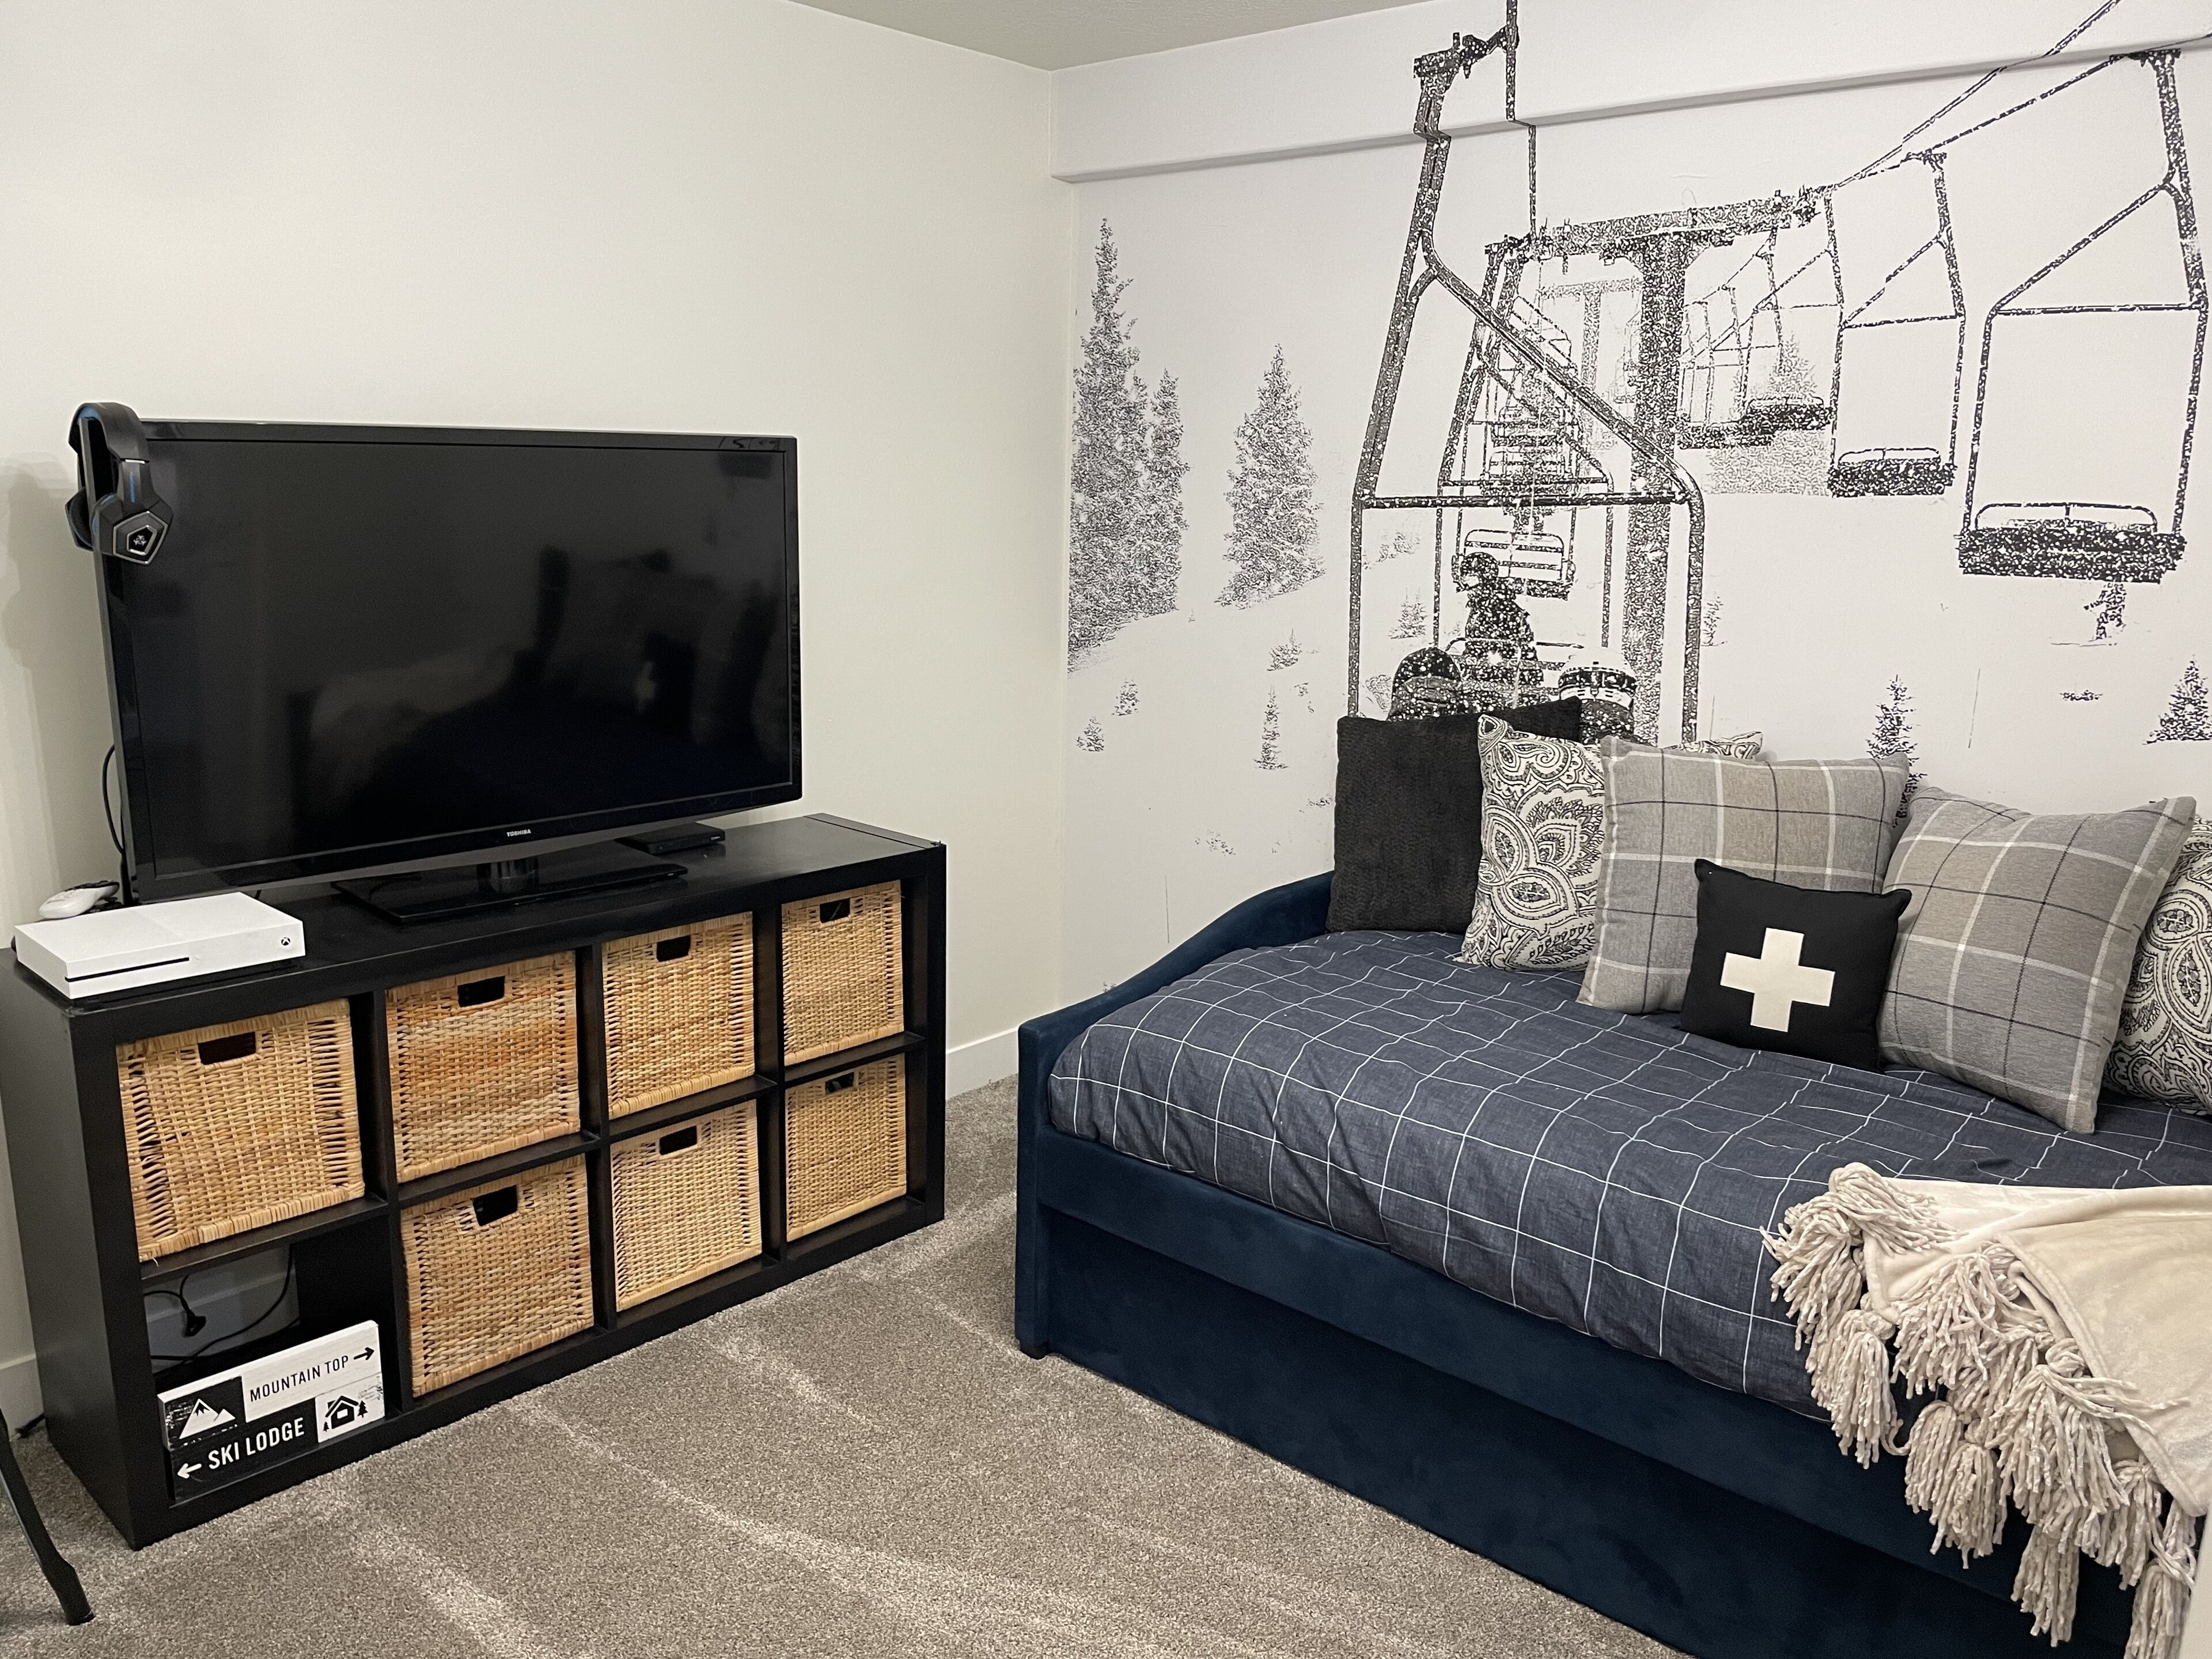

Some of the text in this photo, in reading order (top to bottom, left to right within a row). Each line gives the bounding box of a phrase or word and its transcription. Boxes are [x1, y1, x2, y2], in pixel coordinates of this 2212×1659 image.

[506, 829, 531, 837] TOSHIBA
[250, 1355, 349, 1402] MOUNTAIN TOP
[208, 1417, 305, 1469] SKI LODGE
